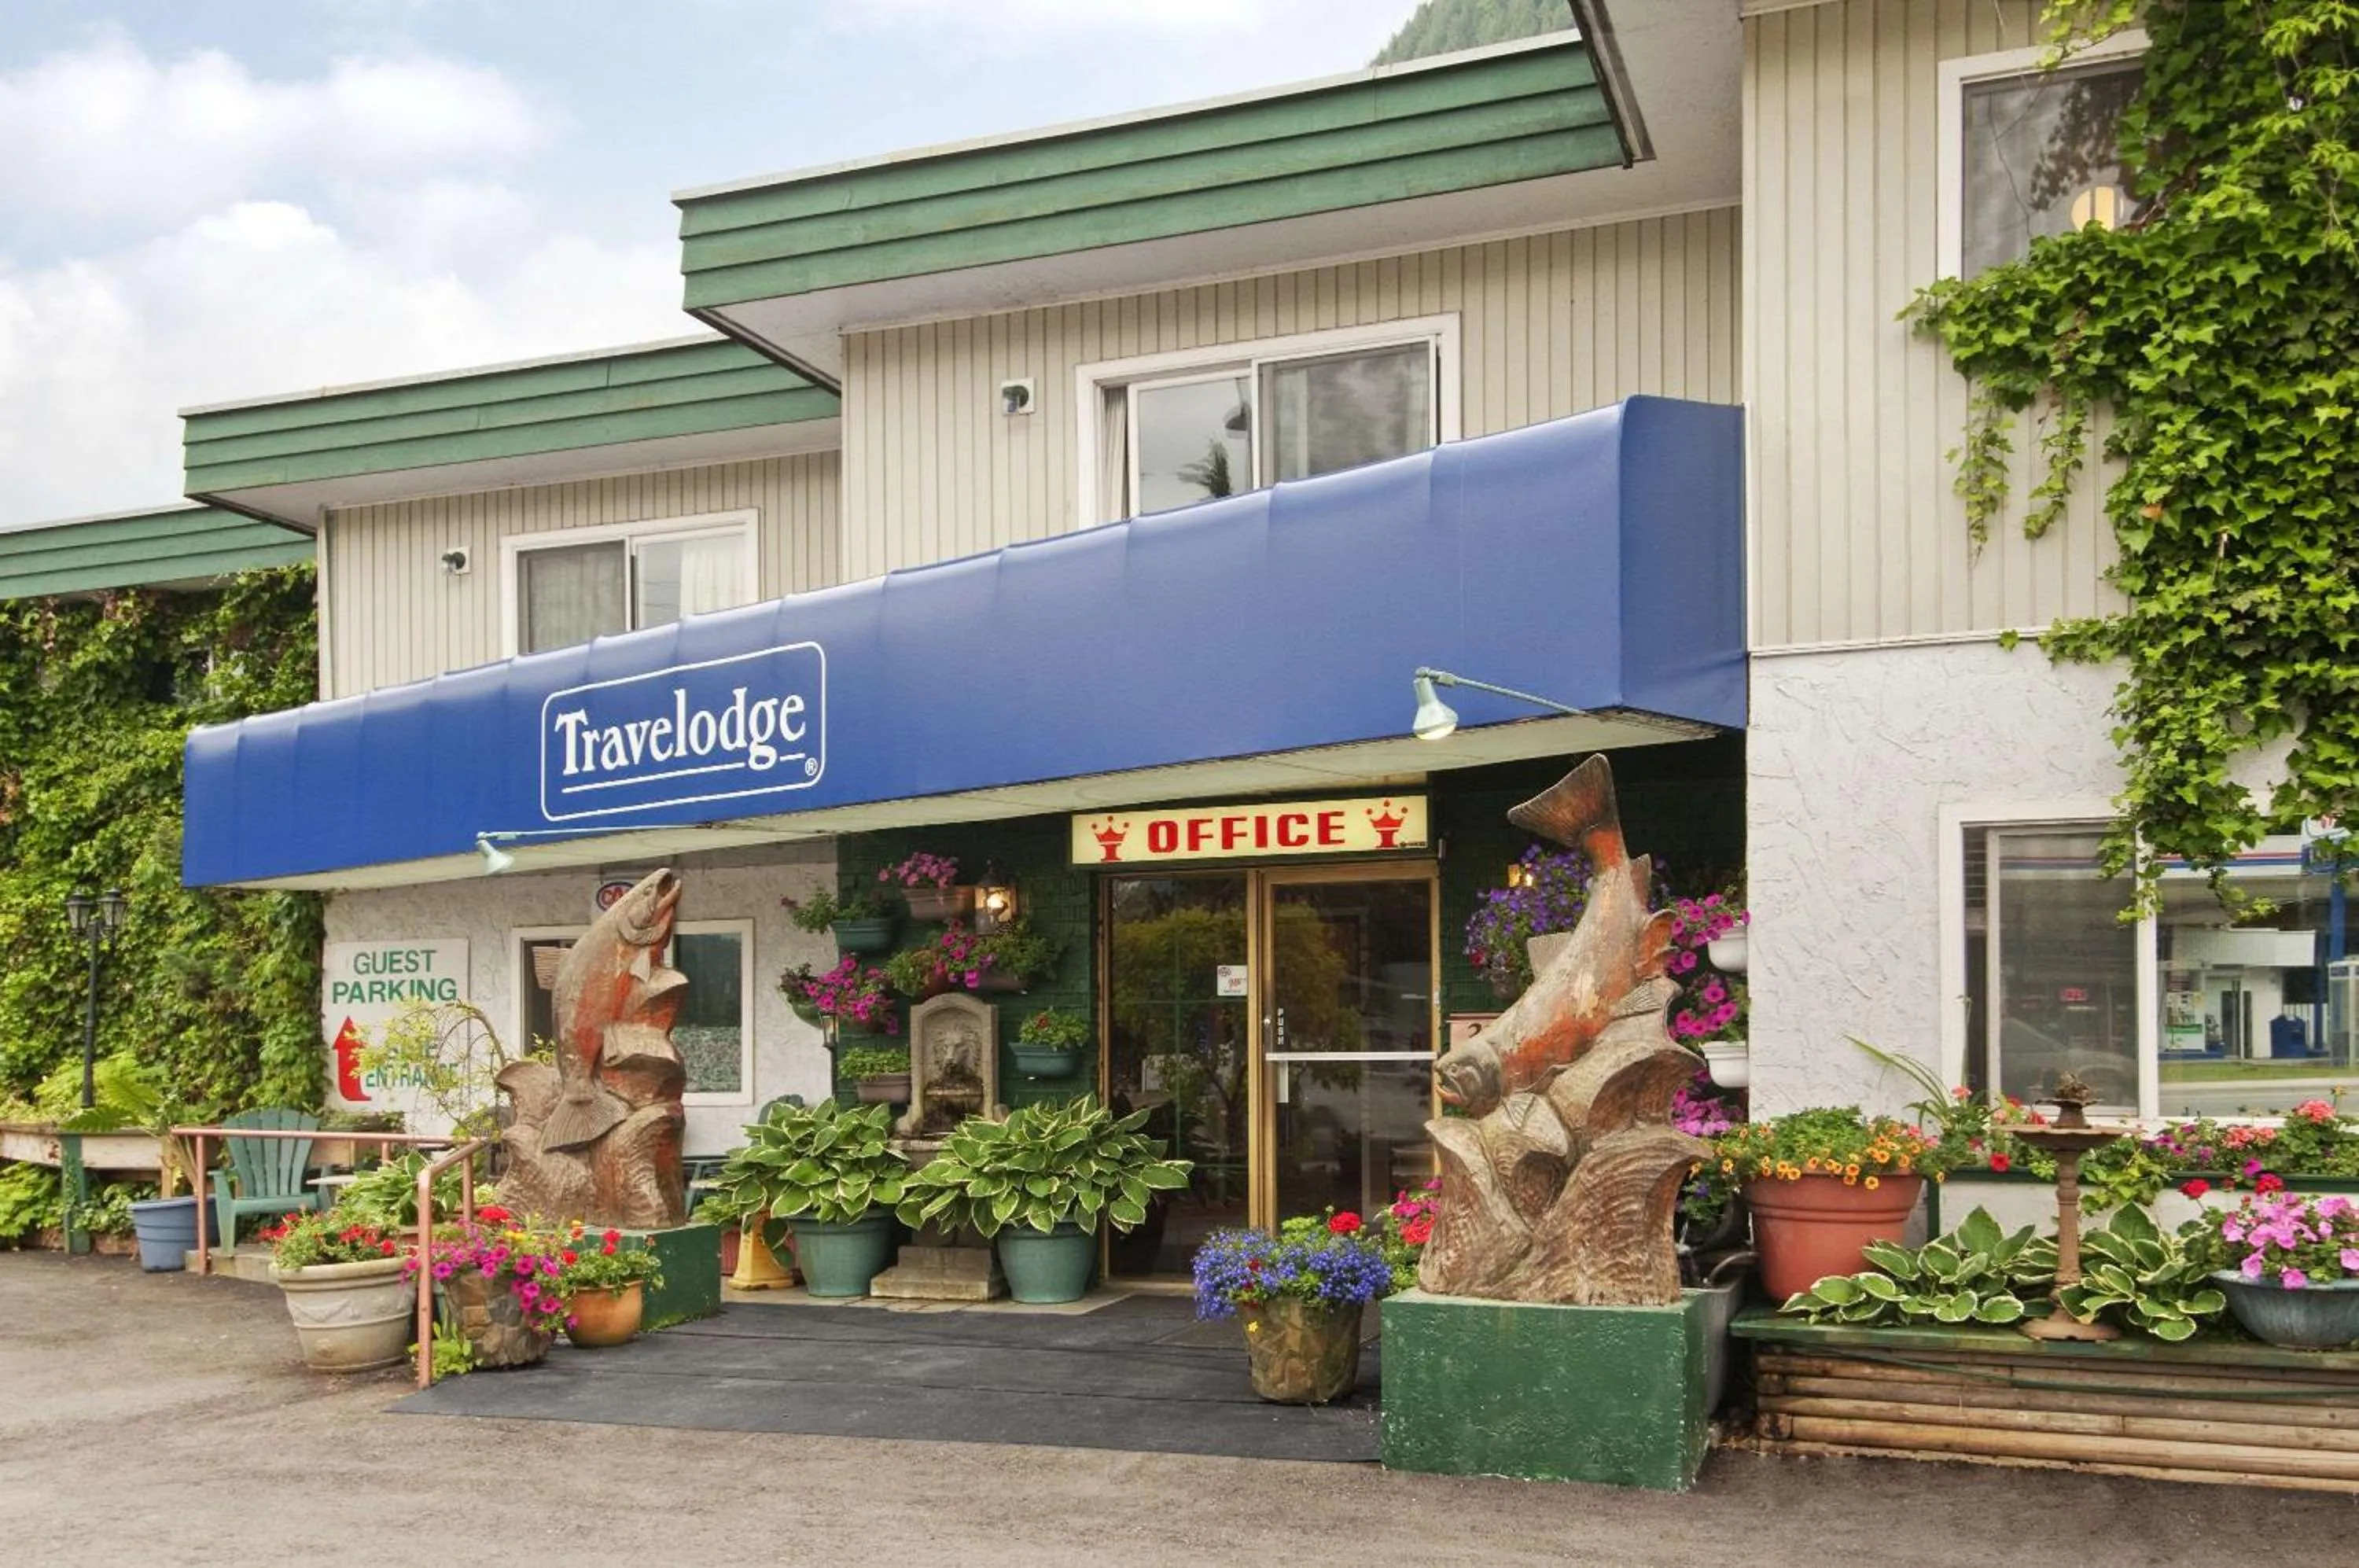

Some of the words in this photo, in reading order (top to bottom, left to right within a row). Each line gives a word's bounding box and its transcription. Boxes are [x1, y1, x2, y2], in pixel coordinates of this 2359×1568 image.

[555, 686, 806, 775] Travelodge
[1147, 811, 1345, 853] OFFICE
[601, 886, 630, 907] CA
[354, 949, 436, 975] GUEST
[333, 978, 458, 1004] PARKING
